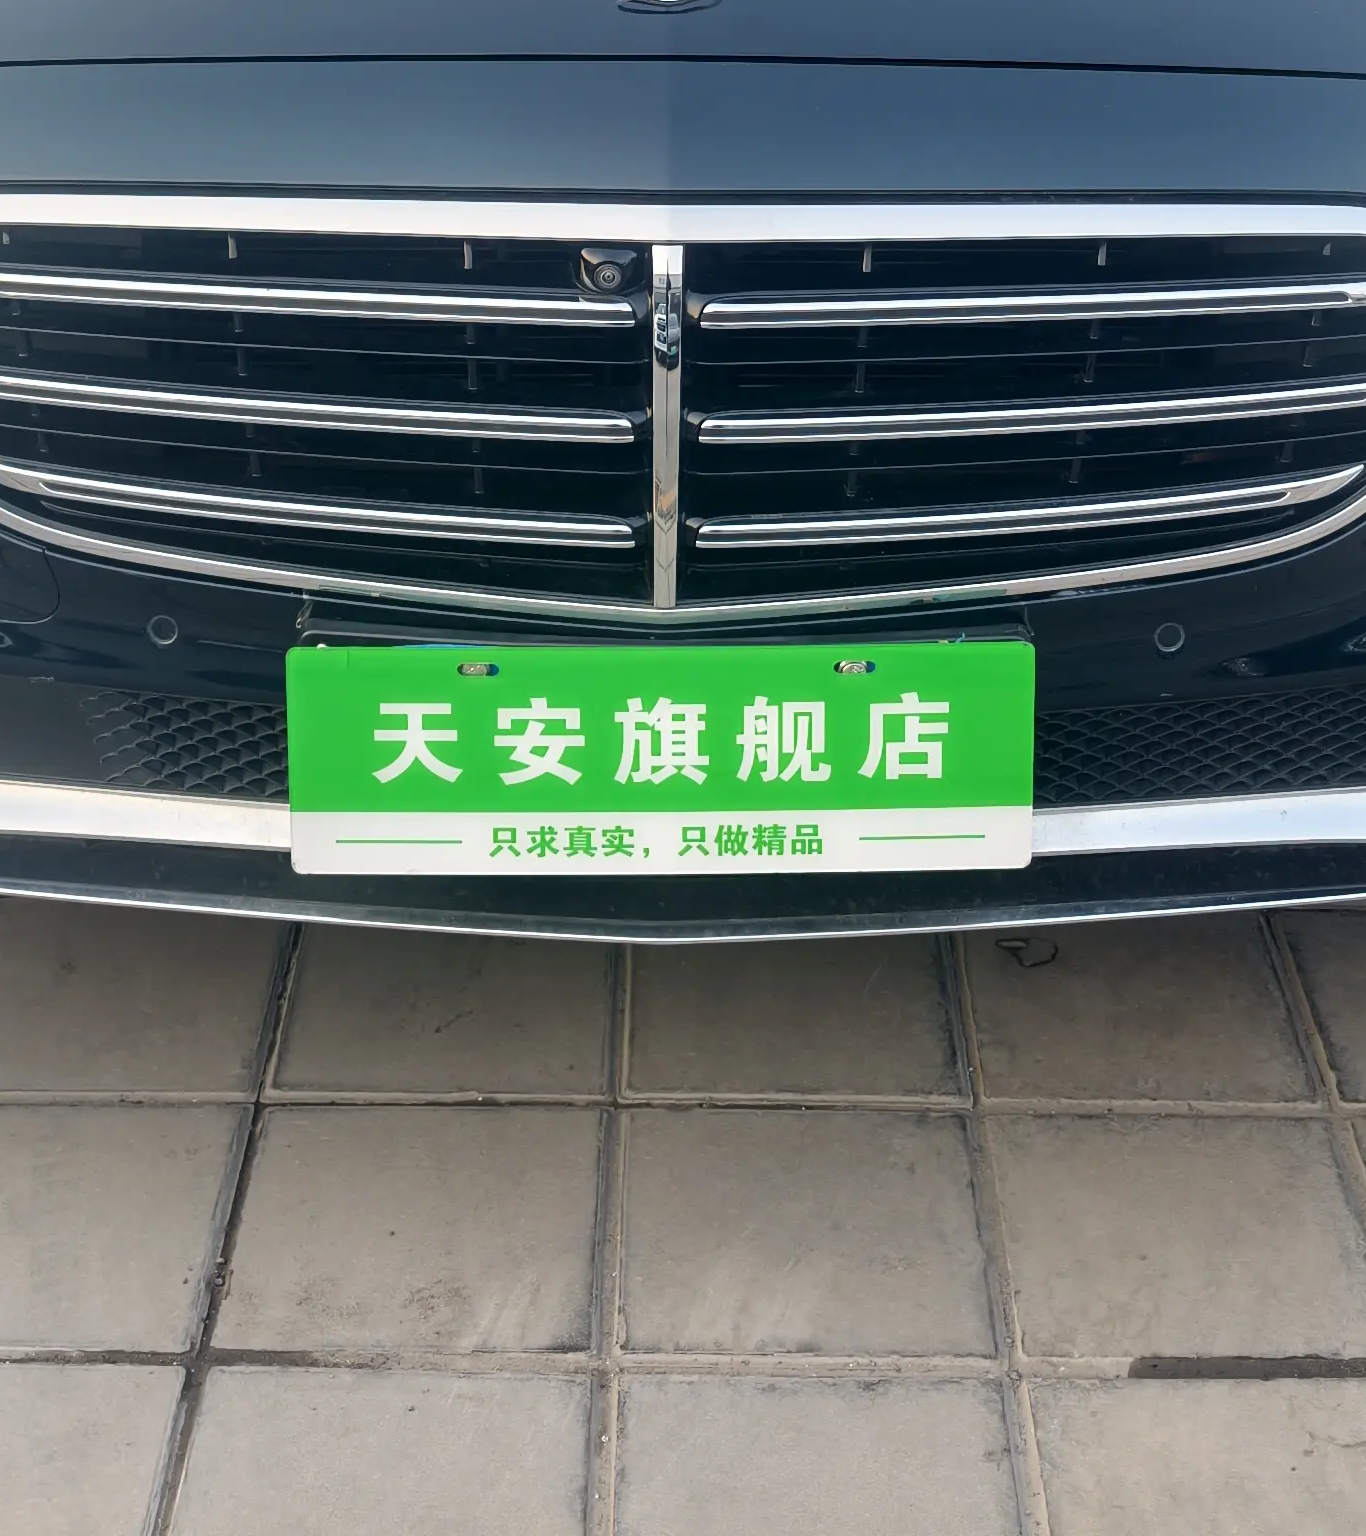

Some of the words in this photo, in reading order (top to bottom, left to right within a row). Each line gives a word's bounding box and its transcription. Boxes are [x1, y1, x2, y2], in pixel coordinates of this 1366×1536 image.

[371, 692, 951, 786] 天安旗舰店
